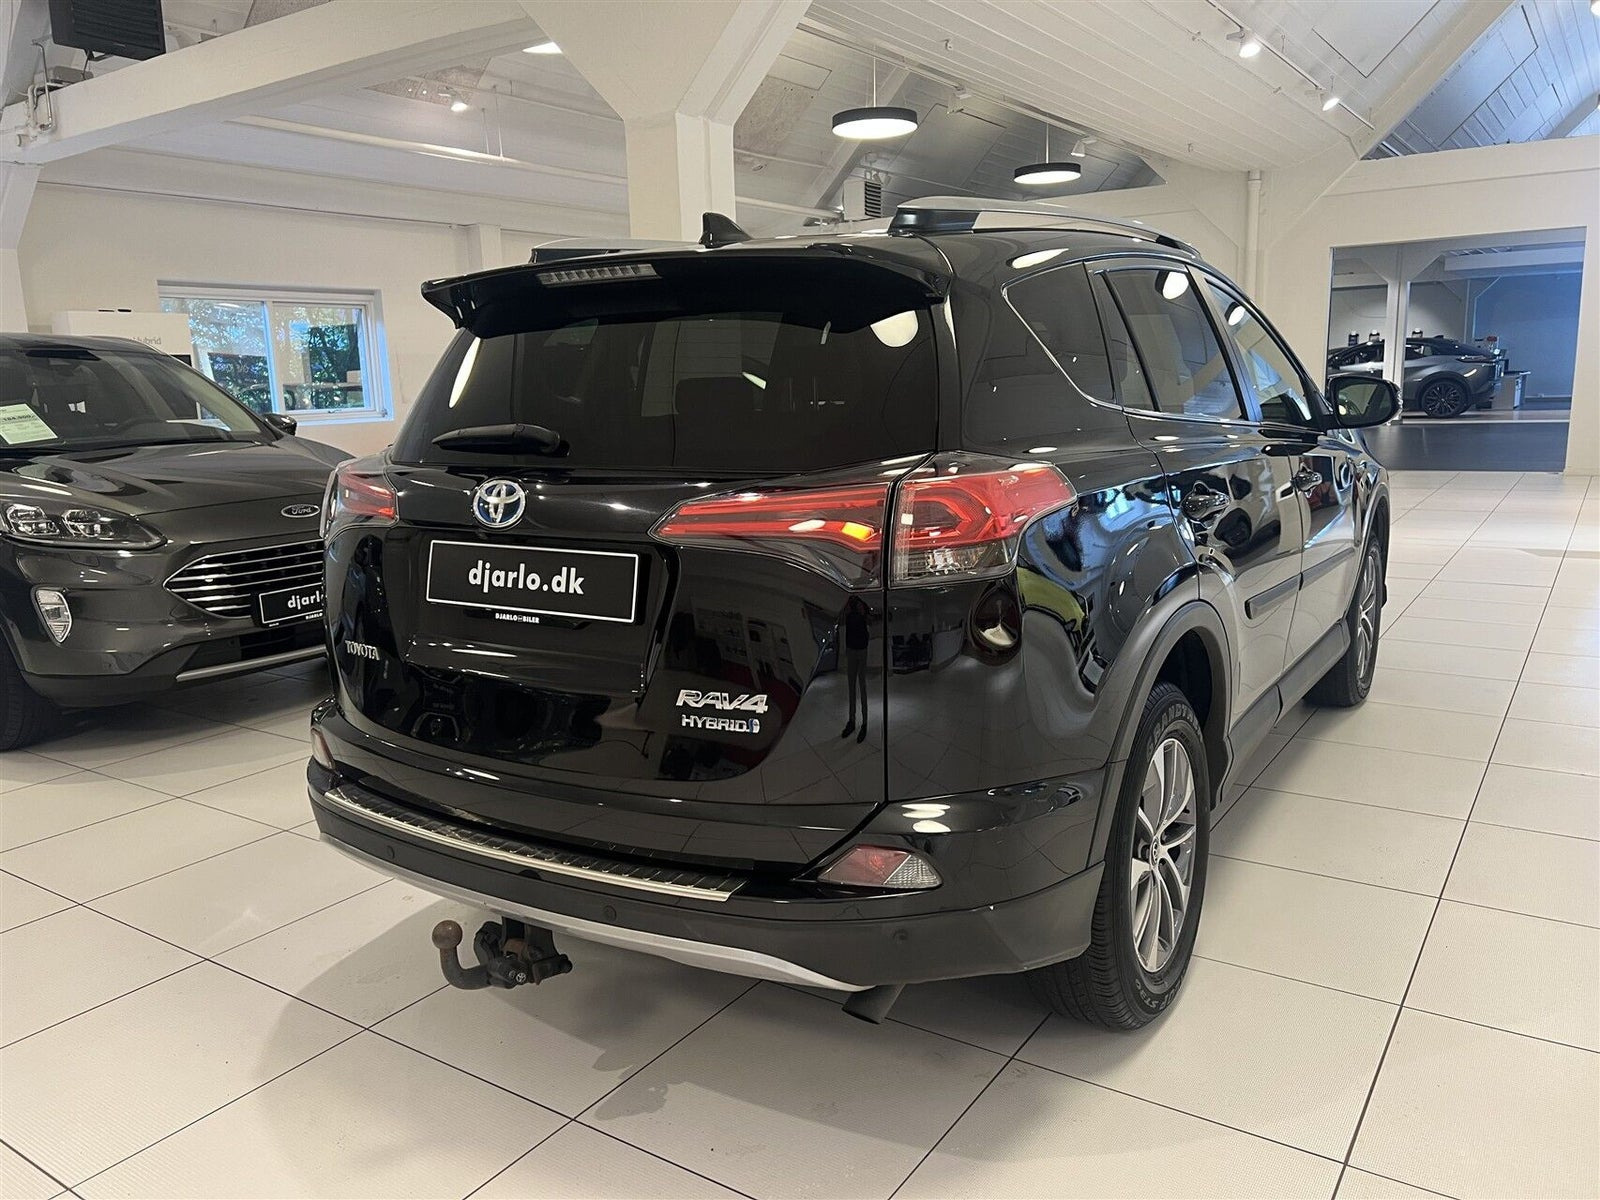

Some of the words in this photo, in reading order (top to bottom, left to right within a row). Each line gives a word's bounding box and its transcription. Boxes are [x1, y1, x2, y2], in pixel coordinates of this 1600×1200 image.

[290, 505, 313, 515] Ford
[468, 560, 585, 595] djarlo.dk
[287, 590, 324, 610] djarl
[495, 612, 518, 622] DJARLO
[522, 615, 540, 624] BILER
[345, 640, 380, 661] TOYOTA
[676, 689, 769, 714] RAV4
[681, 714, 747, 733] HYBRID
